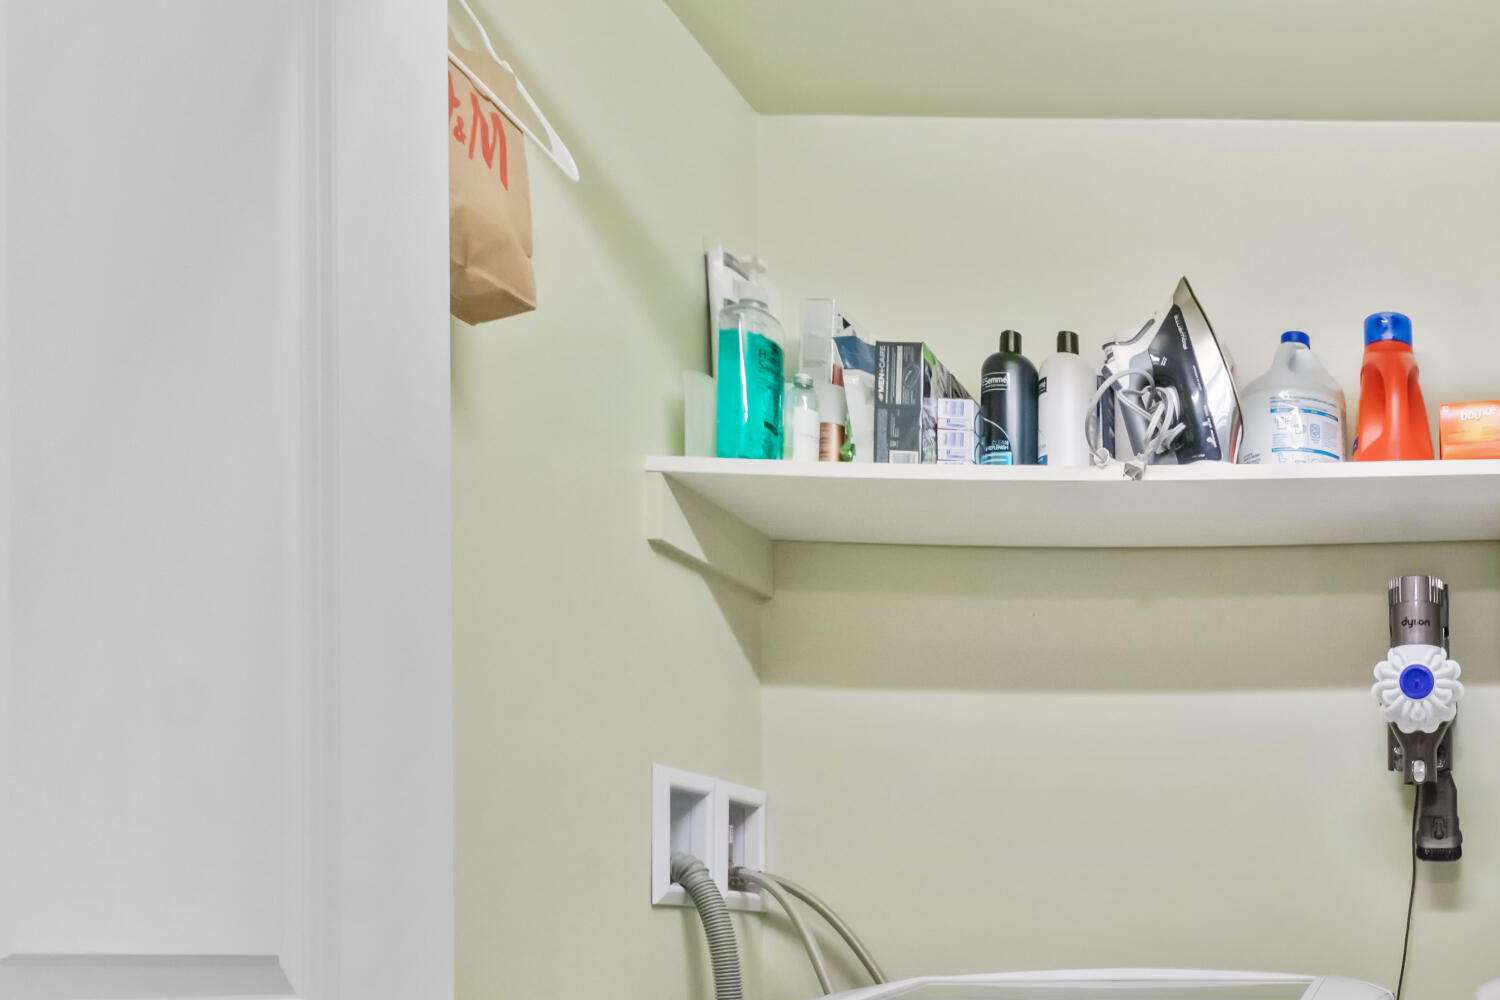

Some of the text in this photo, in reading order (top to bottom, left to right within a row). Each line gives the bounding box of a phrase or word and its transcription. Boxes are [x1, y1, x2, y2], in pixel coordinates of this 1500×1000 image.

[877, 345, 886, 393] MEN+CARE
[1460, 405, 1497, 422] bounce
[1401, 616, 1430, 629] dyson
